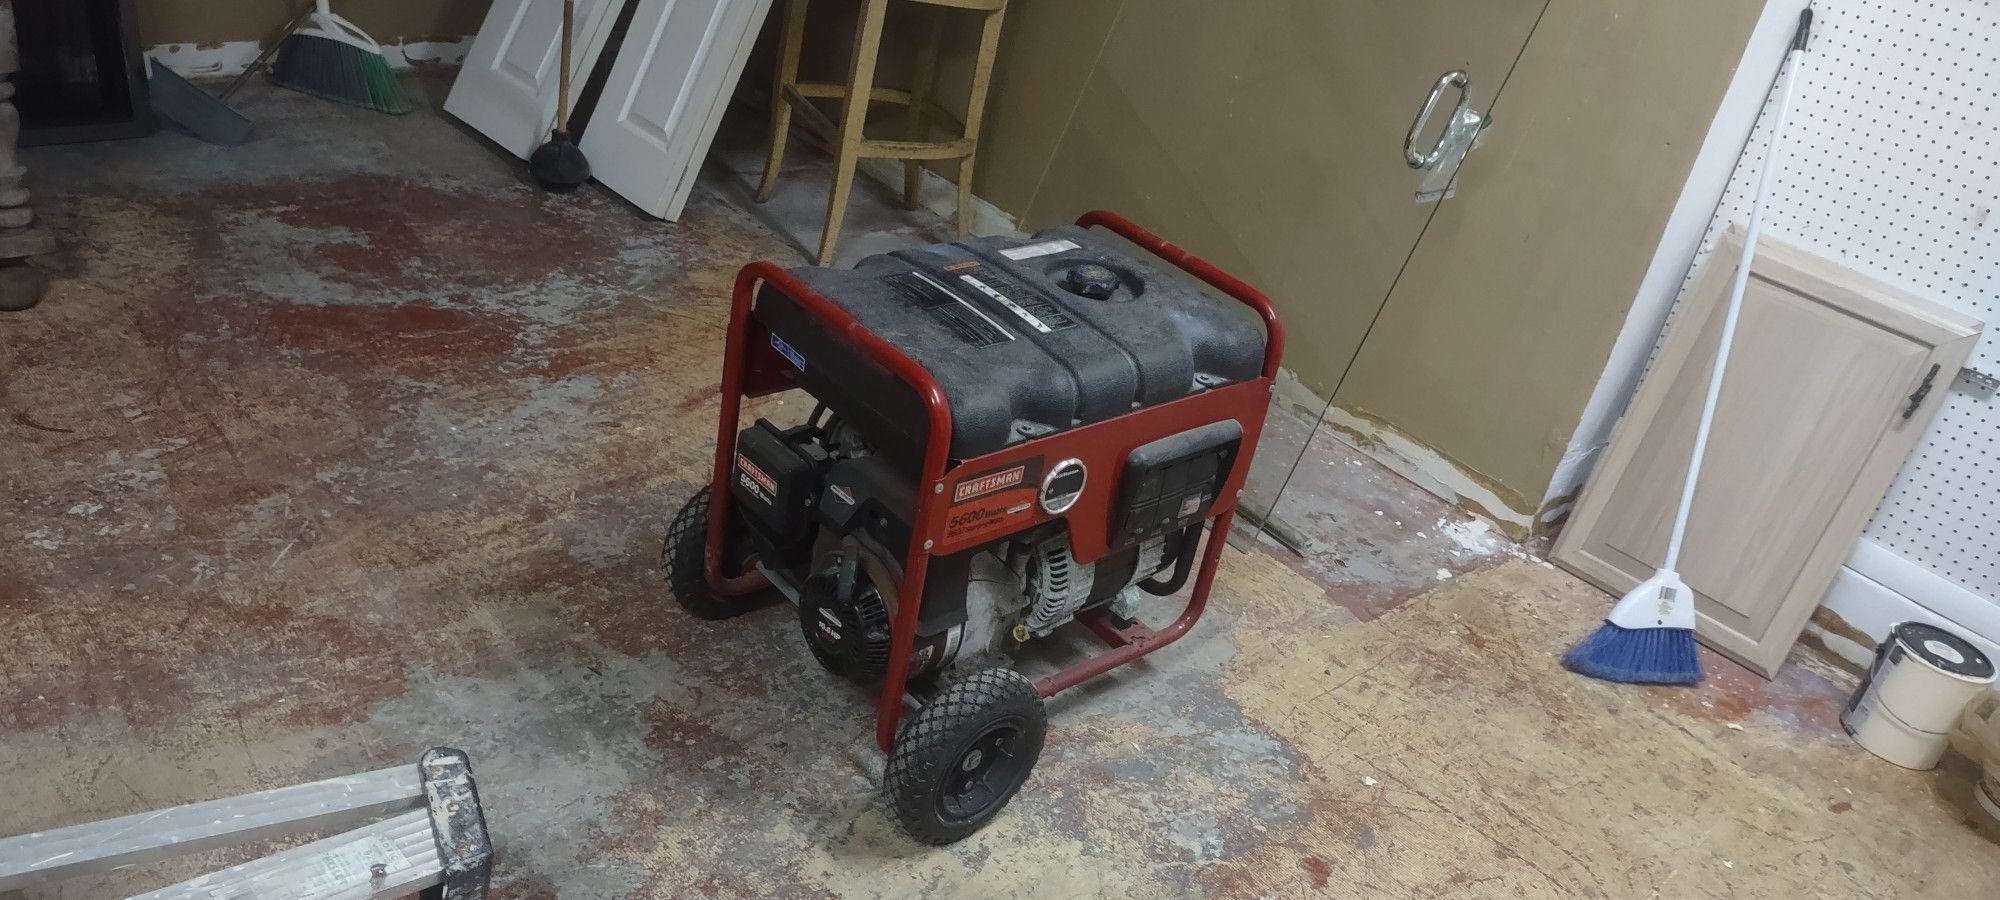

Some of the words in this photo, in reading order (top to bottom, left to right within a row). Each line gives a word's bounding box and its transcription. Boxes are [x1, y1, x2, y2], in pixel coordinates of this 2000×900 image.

[740, 457, 775, 493] CRAFTSMAN
[741, 473, 760, 494] 5600
[958, 470, 1021, 497] CRAFTSMAN
[949, 508, 985, 528] 5600
[818, 621, 831, 634] 10.0
[830, 629, 841, 640] HP
